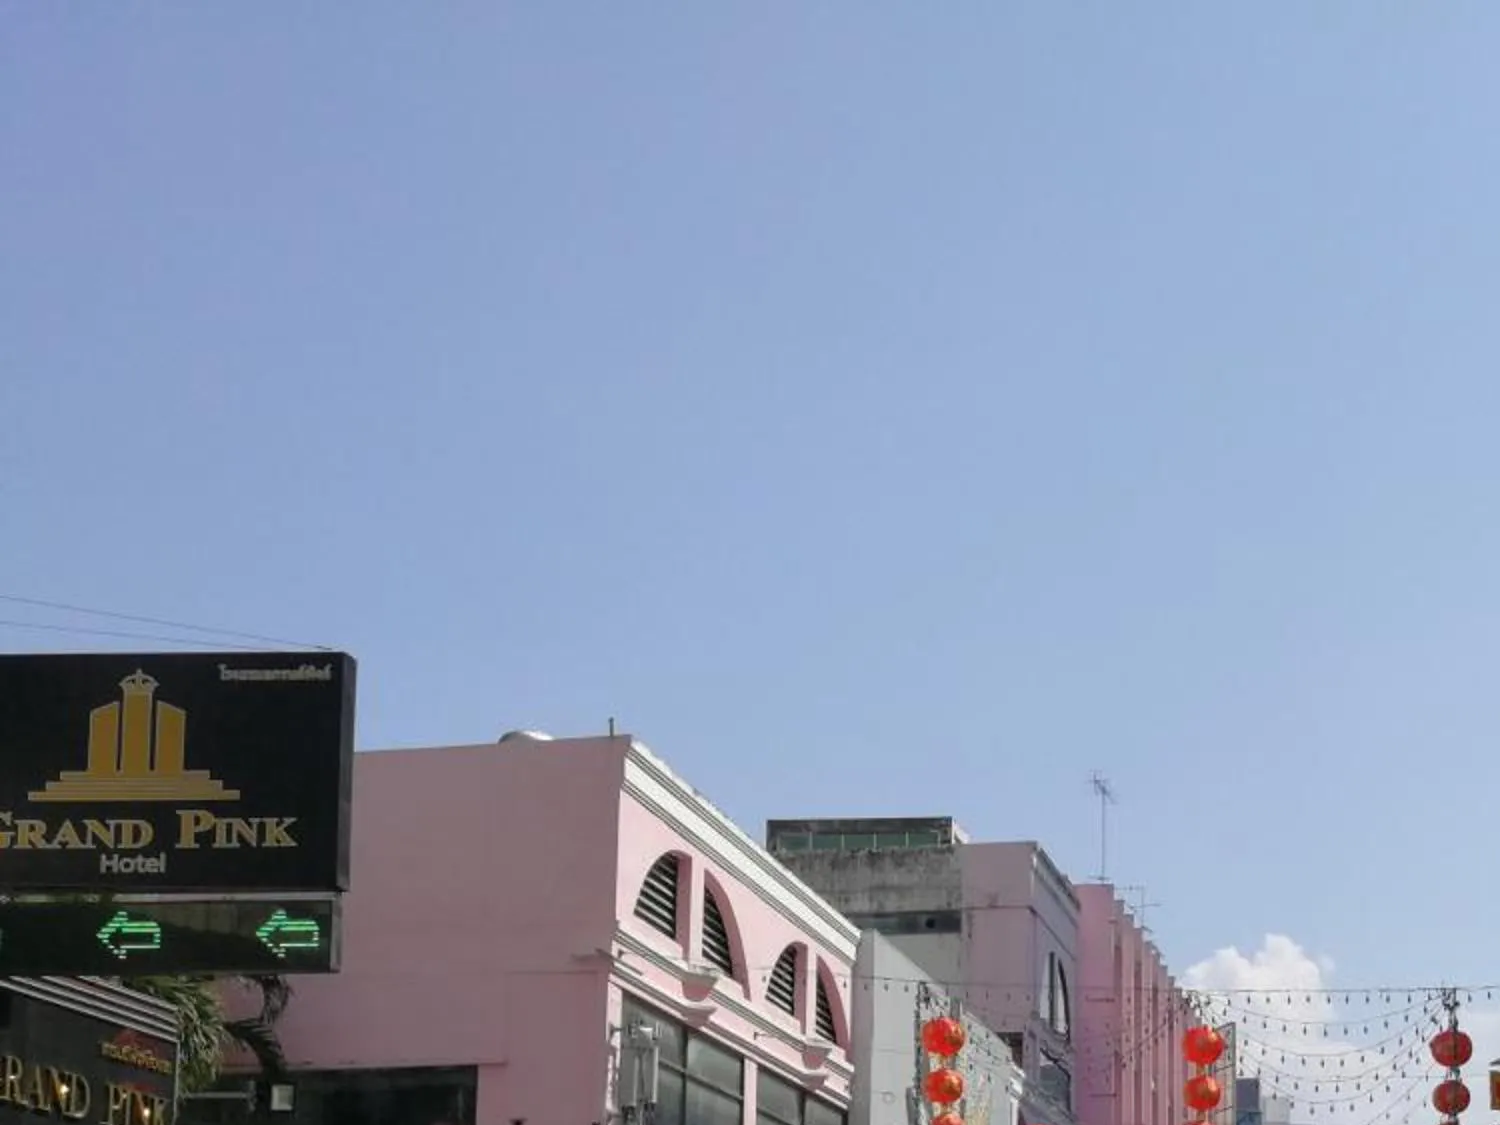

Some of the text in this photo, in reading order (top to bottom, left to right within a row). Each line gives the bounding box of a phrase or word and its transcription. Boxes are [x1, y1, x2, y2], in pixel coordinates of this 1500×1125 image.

[175, 809, 298, 849] PINK
[100, 852, 166, 874] Hotel
[0, 1055, 91, 1119] RAND
